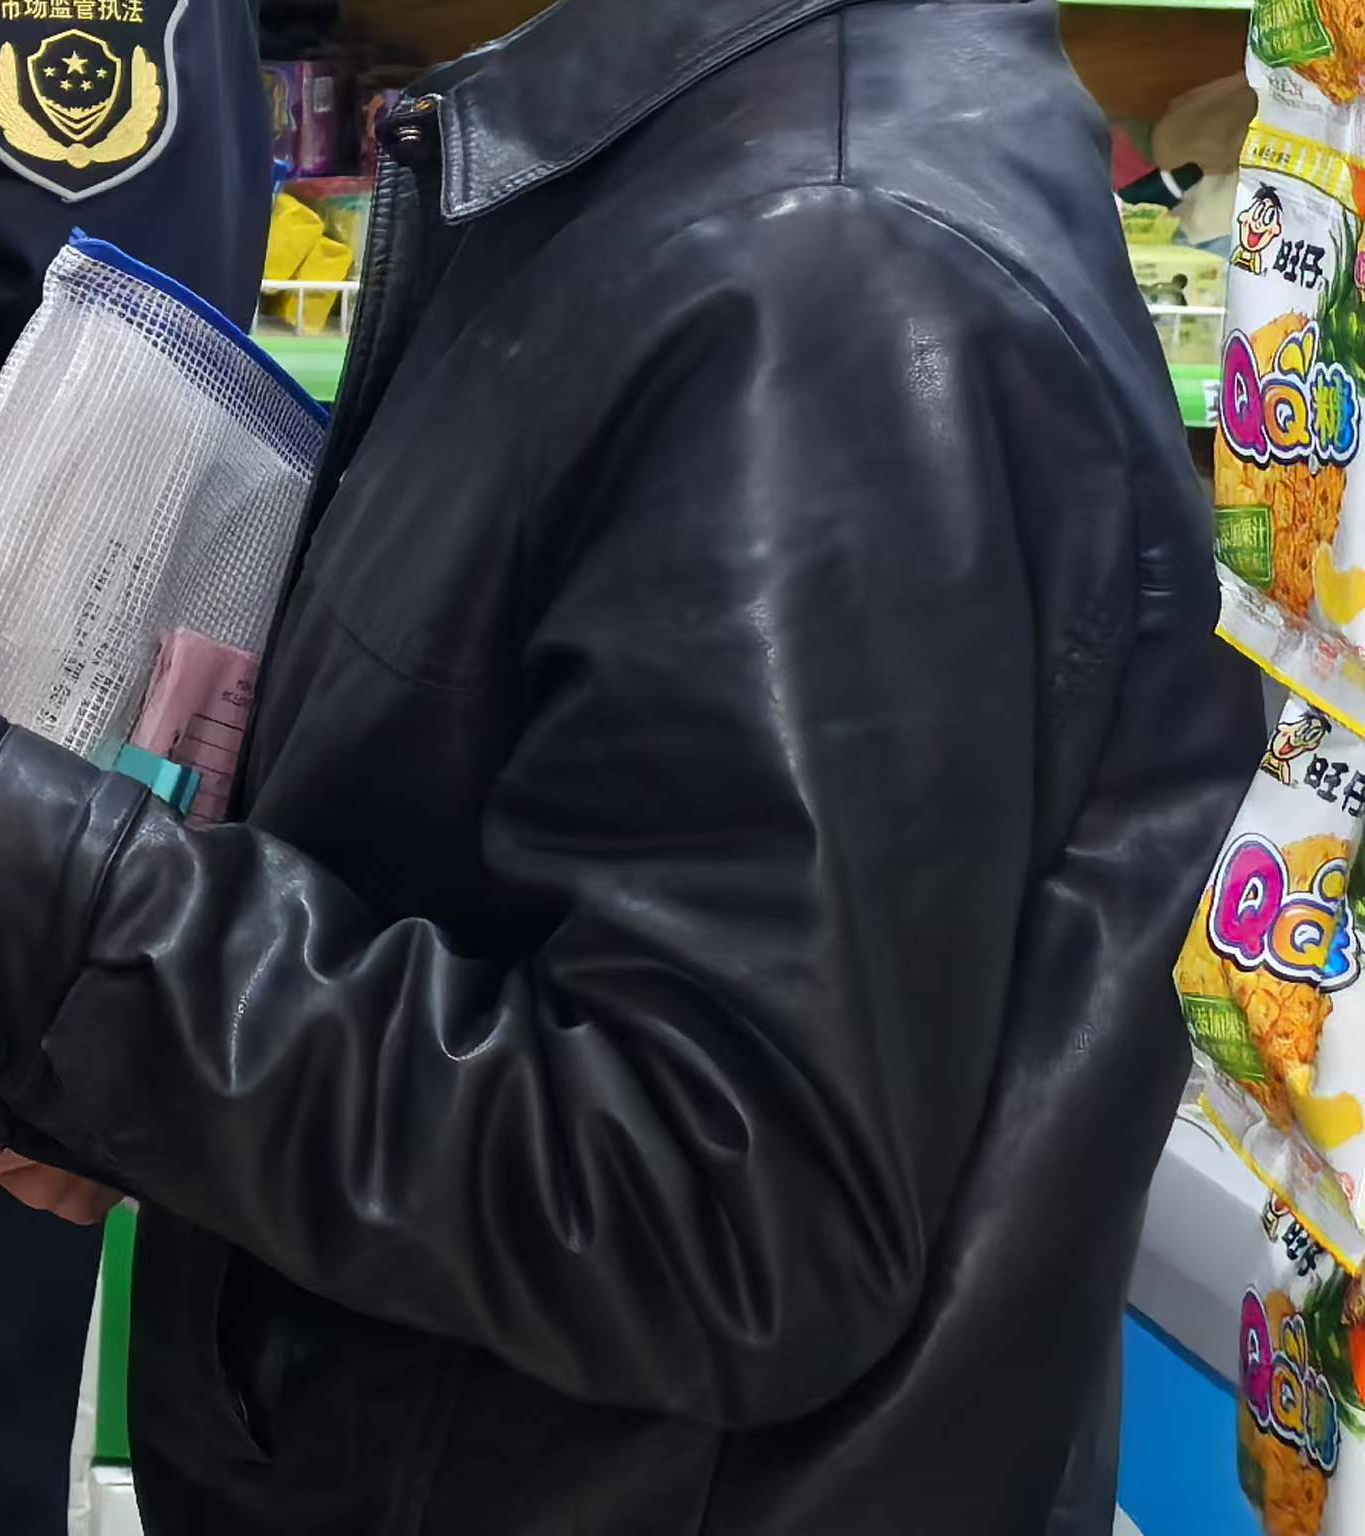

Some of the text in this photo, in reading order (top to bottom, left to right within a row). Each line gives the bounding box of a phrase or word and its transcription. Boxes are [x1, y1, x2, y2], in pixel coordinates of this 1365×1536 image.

[1272, 238, 1324, 291] 旺仔
[1220, 324, 1358, 465] QQ糖
[1206, 832, 1361, 996] QQ
